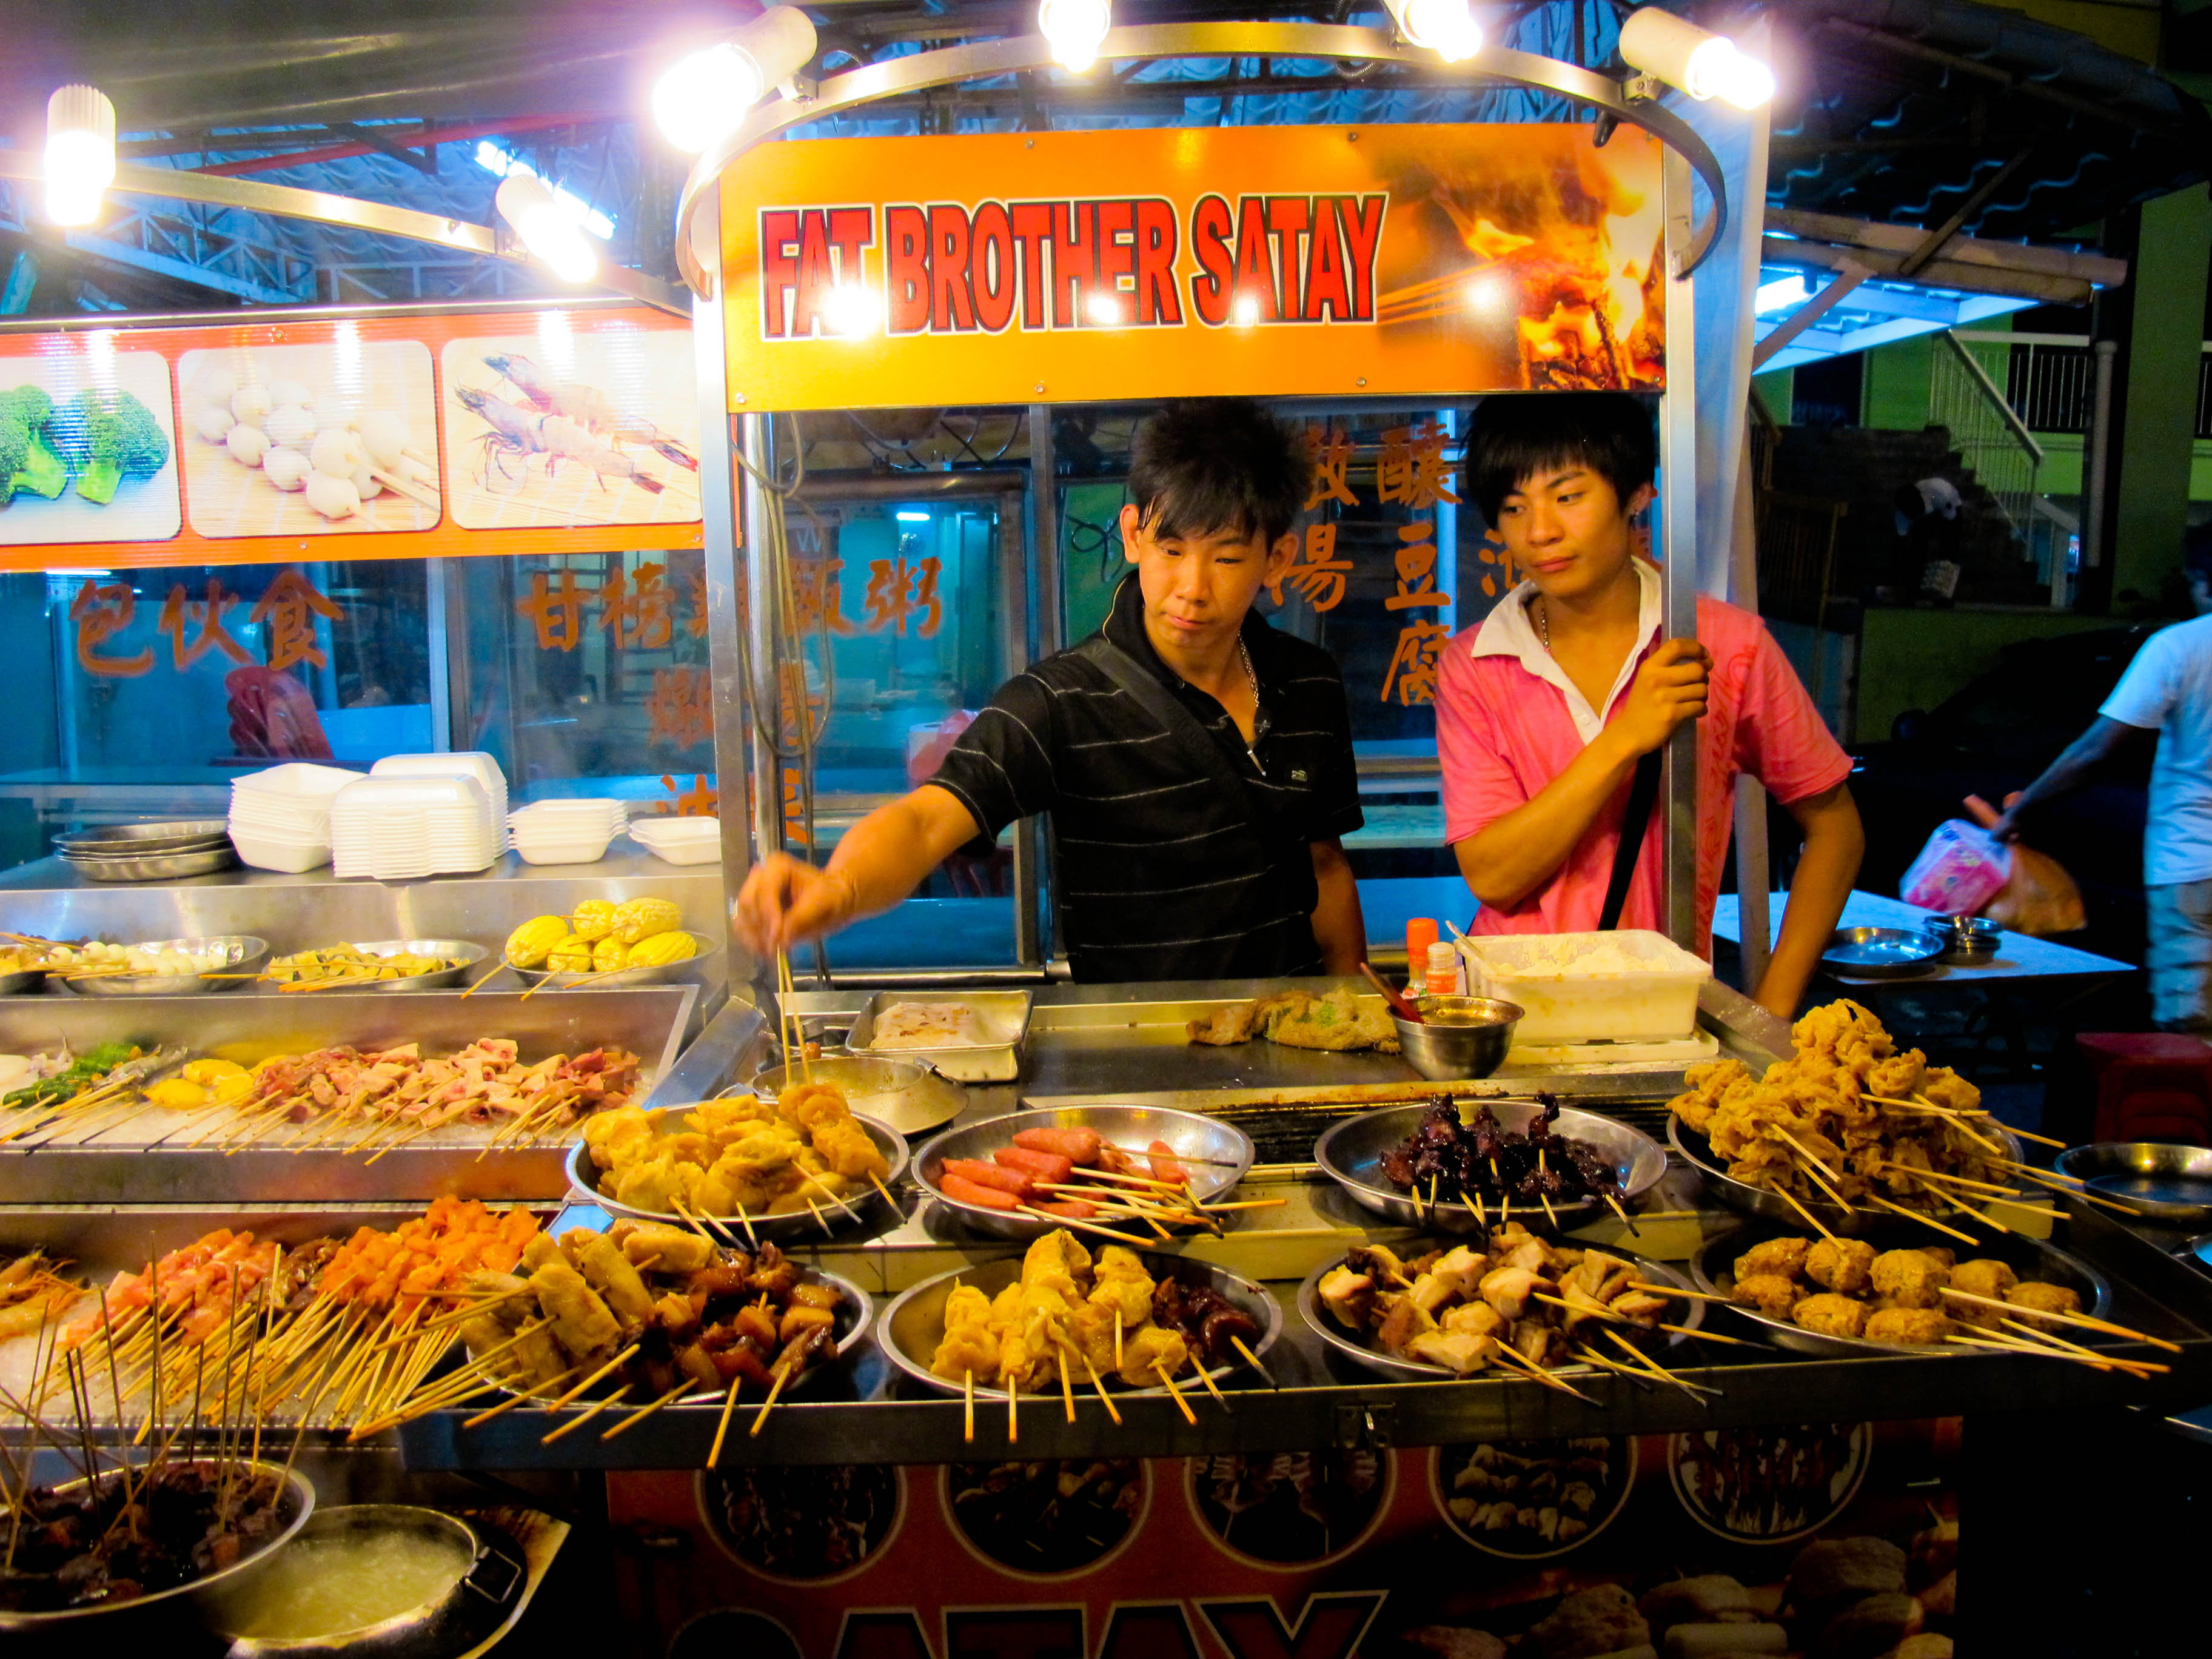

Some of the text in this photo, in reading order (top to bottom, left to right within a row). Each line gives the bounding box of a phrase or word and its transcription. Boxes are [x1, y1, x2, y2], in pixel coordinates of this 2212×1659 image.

[760, 193, 1387, 340] FAT BROTHER SATAY
[69, 569, 345, 677] 包伙食
